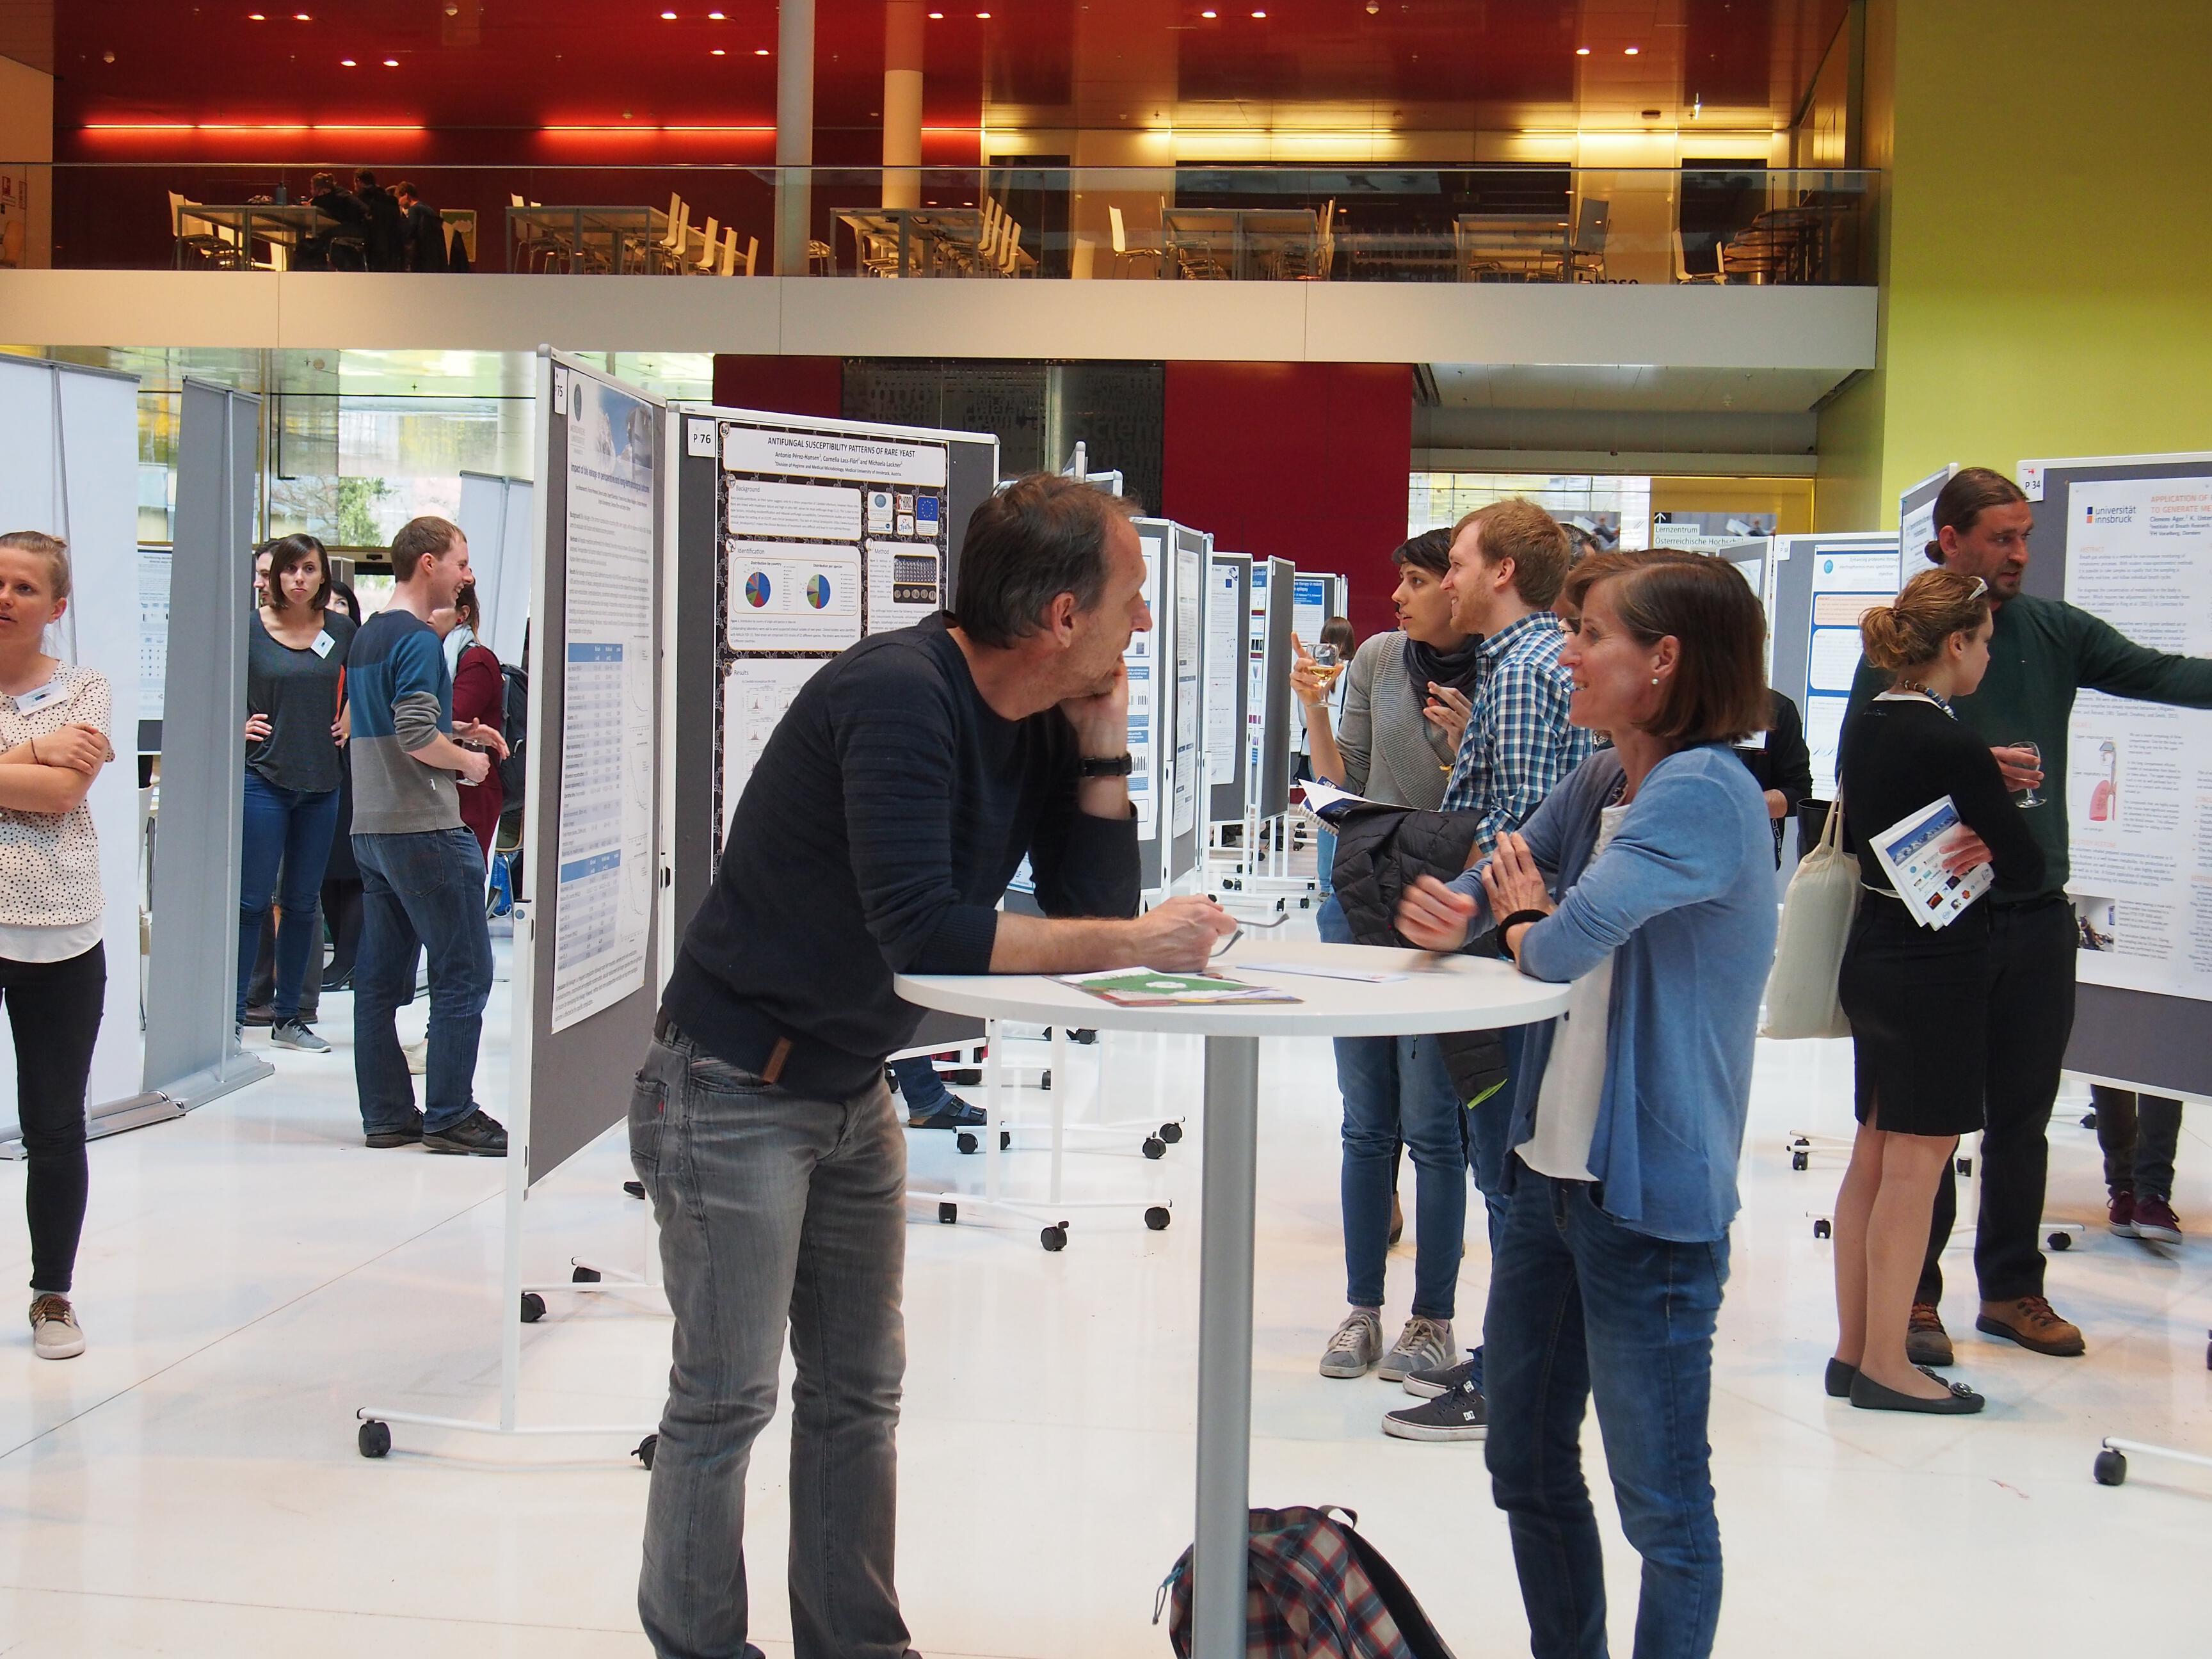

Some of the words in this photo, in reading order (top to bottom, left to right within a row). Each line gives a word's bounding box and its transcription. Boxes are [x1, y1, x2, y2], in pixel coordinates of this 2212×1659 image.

[693, 433, 698, 443] P
[700, 433, 711, 444] 76
[767, 437, 804, 447] ANTIFUNGAL
[805, 440, 848, 451] SUSCEPTIBILITY
[849, 444, 875, 454] PATTERNS
[885, 448, 898, 456] RARE
[2025, 481, 2030, 490] P
[2032, 481, 2040, 490] 34
[2150, 495, 2197, 503] APPLICATION
[2095, 505, 2136, 515] universität
[2163, 505, 2199, 513] GENERATE
[2095, 515, 2133, 524] innsbruck
[1655, 536, 1707, 545] Österreichische
